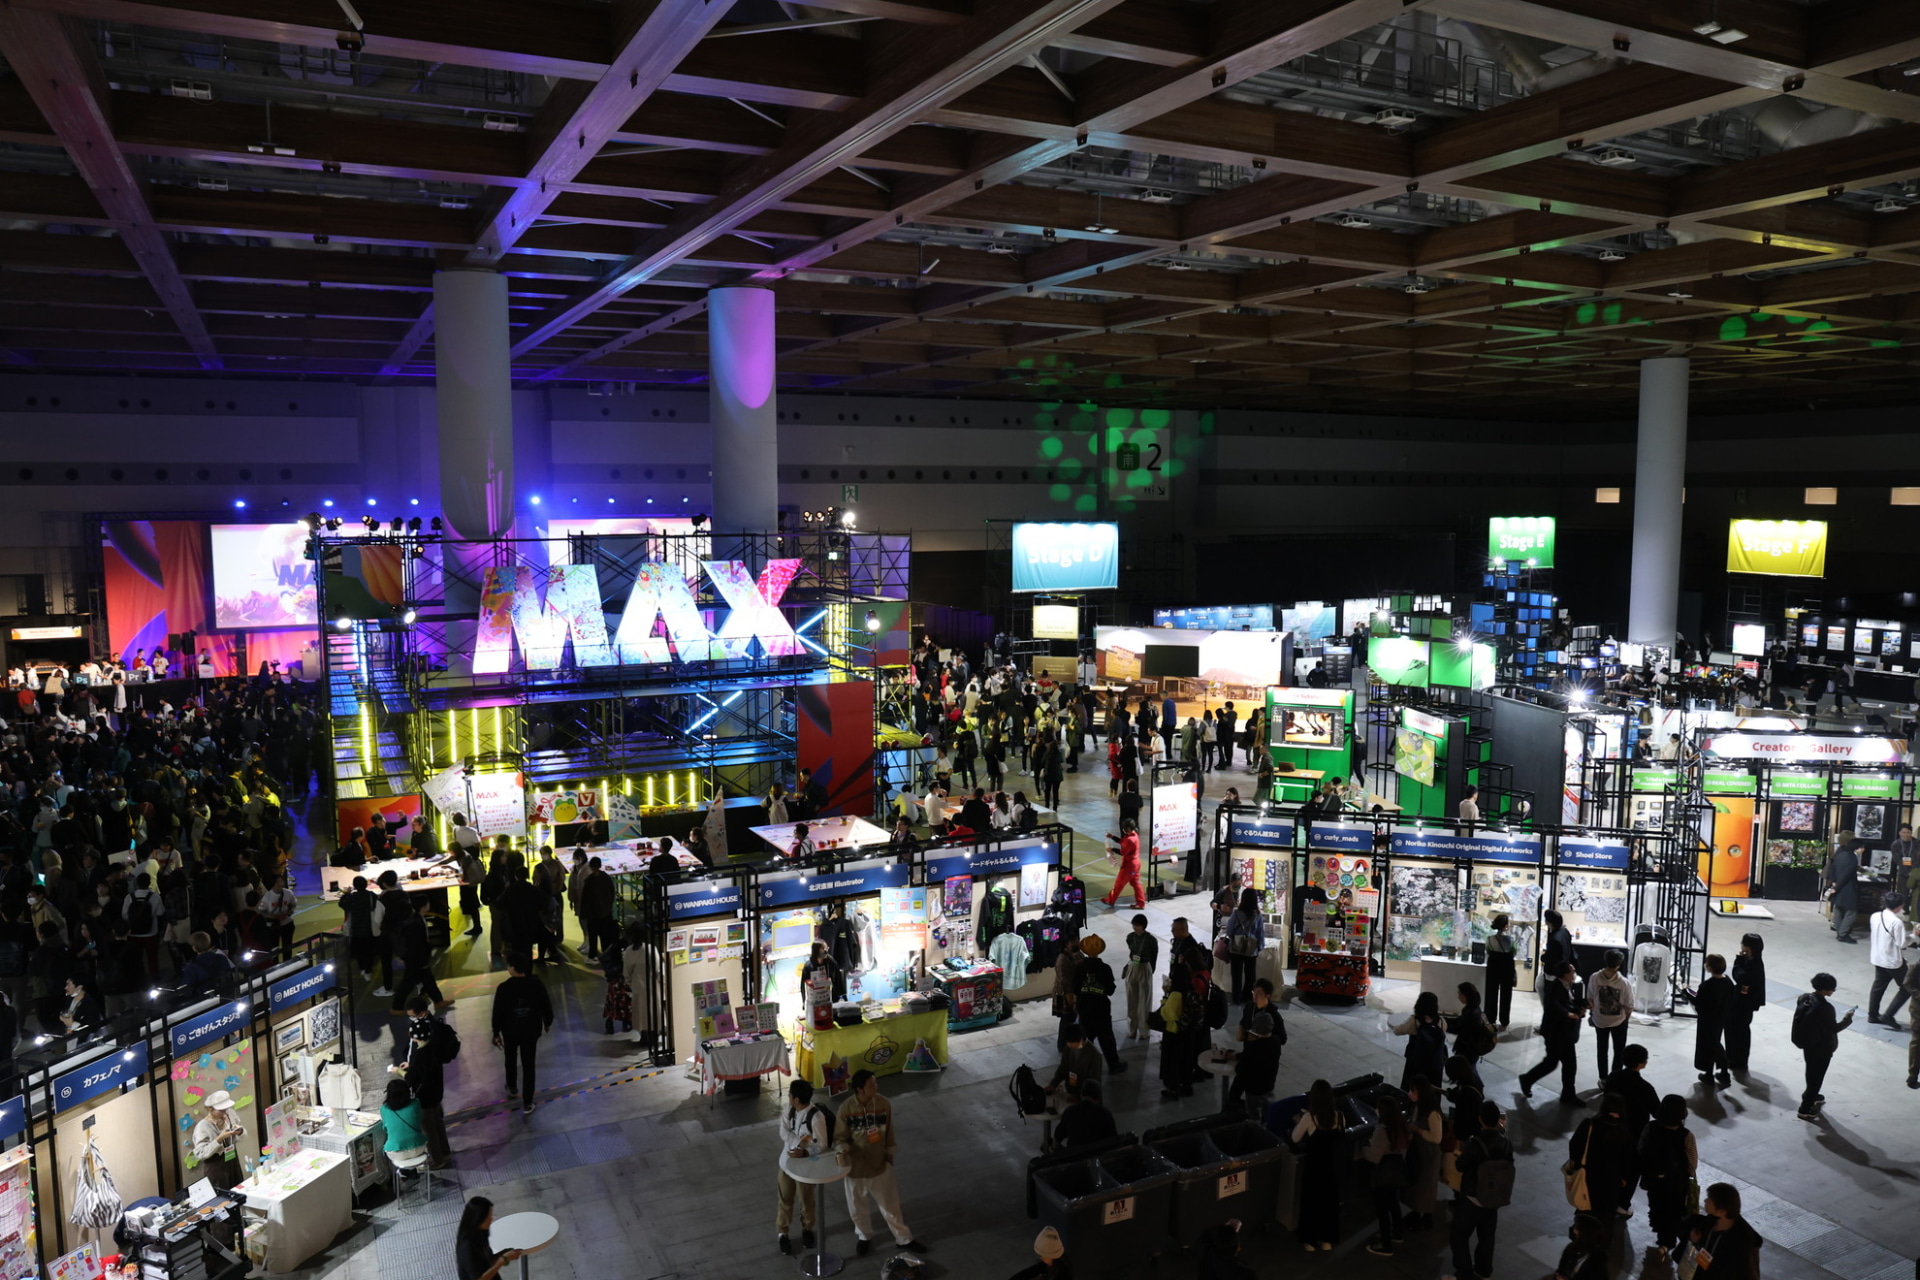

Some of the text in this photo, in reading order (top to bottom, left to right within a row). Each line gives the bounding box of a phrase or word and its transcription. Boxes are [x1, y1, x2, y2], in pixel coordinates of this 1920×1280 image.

[1147, 443, 1162, 471] 2
[1499, 533, 1545, 552] Stage E
[1743, 538, 1810, 557] Stage F
[1028, 543, 1103, 568] Stage D
[472, 558, 806, 674] MAX
[76, 676, 88, 685] Ps
[128, 673, 140, 681] Pr
[1809, 743, 1853, 756] Gallery
[476, 792, 499, 800] MAX
[1158, 803, 1178, 812] MAX
[1405, 839, 1533, 854] Noriko Kinouchi Original Digital Artworks
[1594, 852, 1613, 860] Store
[683, 894, 739, 909] WANPAKU HOUSE
[283, 983, 301, 998] MELT
[301, 973, 324, 990] HOUSE
[188, 1012, 241, 1040] ごきげんスタジオ
[83, 1064, 121, 1088] カフェノマ
